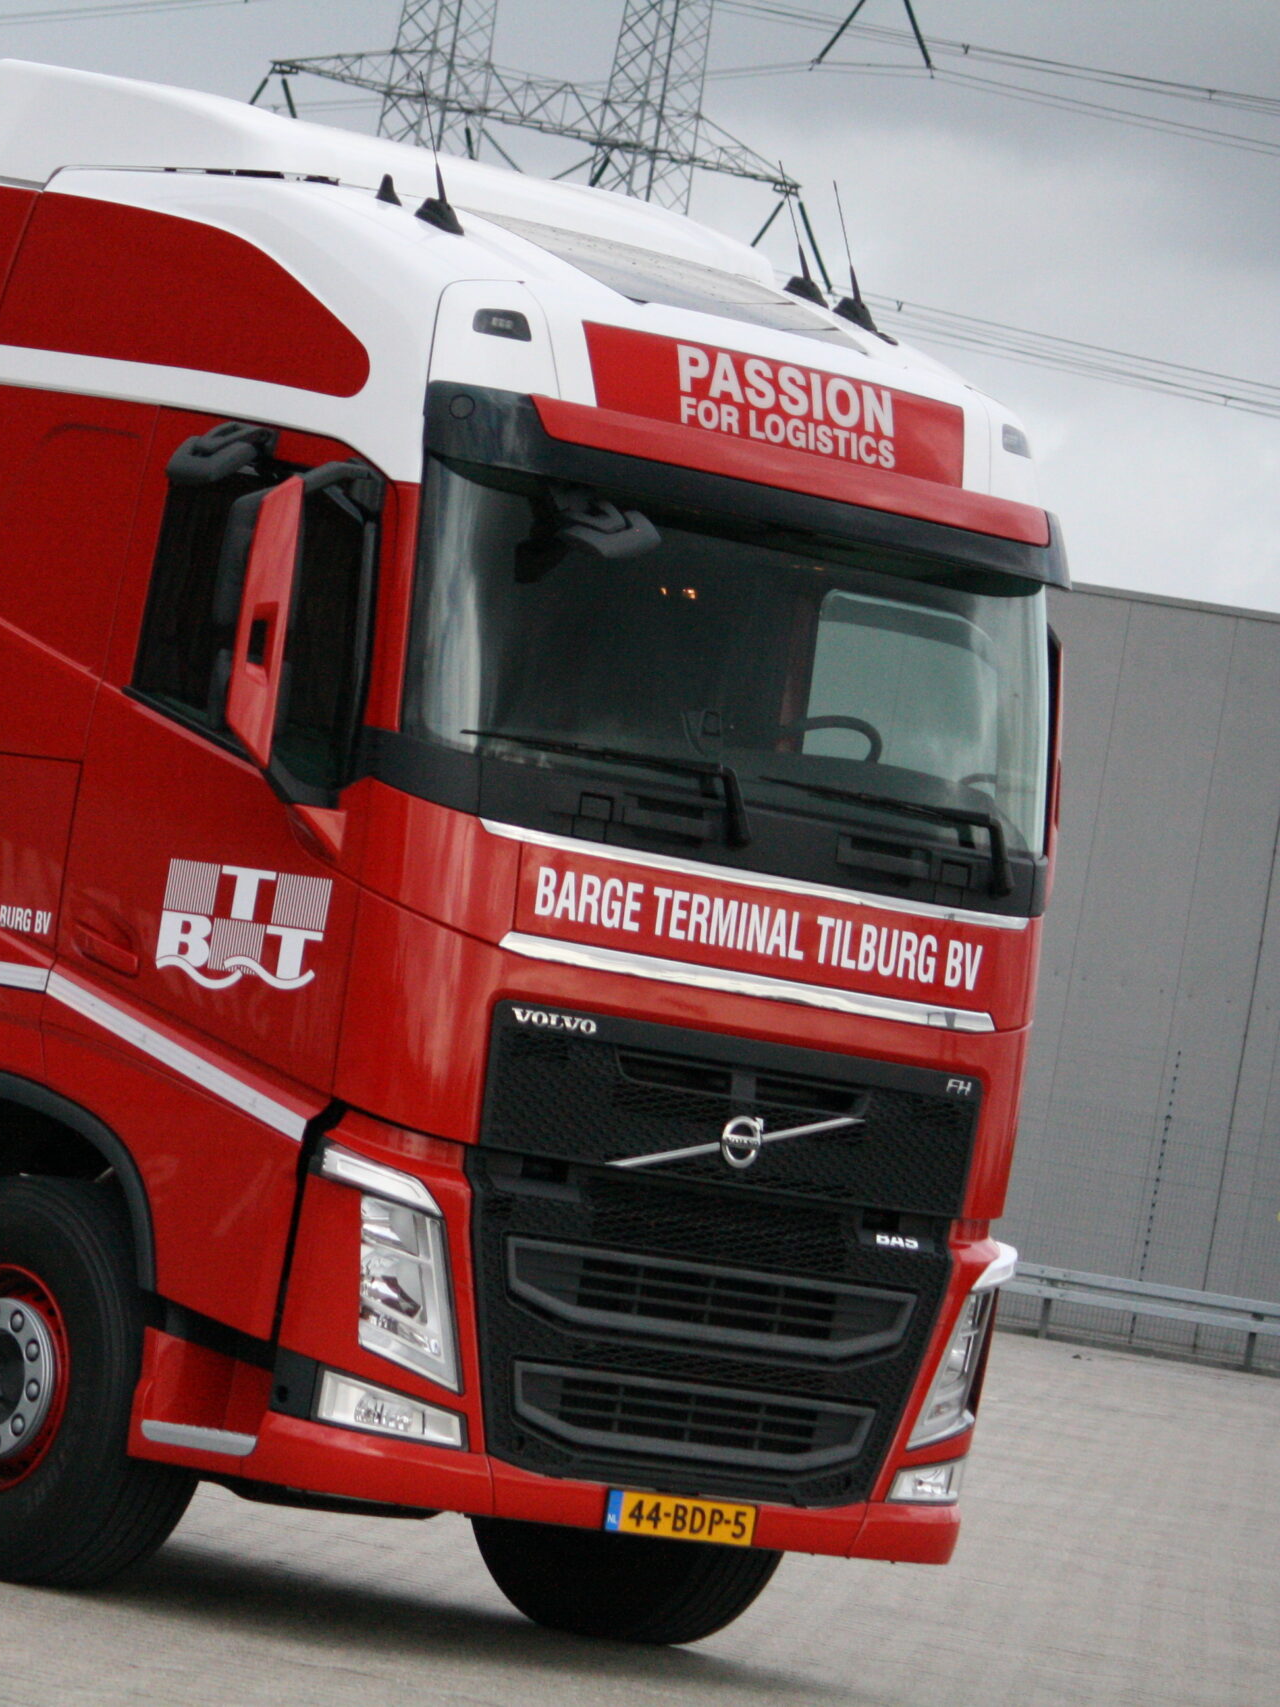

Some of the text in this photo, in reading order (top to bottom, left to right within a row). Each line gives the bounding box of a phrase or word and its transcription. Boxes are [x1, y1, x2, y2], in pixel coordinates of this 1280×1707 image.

[677, 344, 895, 437] PASSION
[680, 396, 896, 469] FOR LOGISTICS
[34, 911, 51, 935] BV
[534, 866, 983, 991] BARGE TERMINAL TILBURG BV
[511, 1007, 597, 1034] VOLVO
[946, 1078, 972, 1096] FH
[876, 1234, 919, 1250] BAS
[607, 1500, 747, 1539] NL 44-BDP-5
